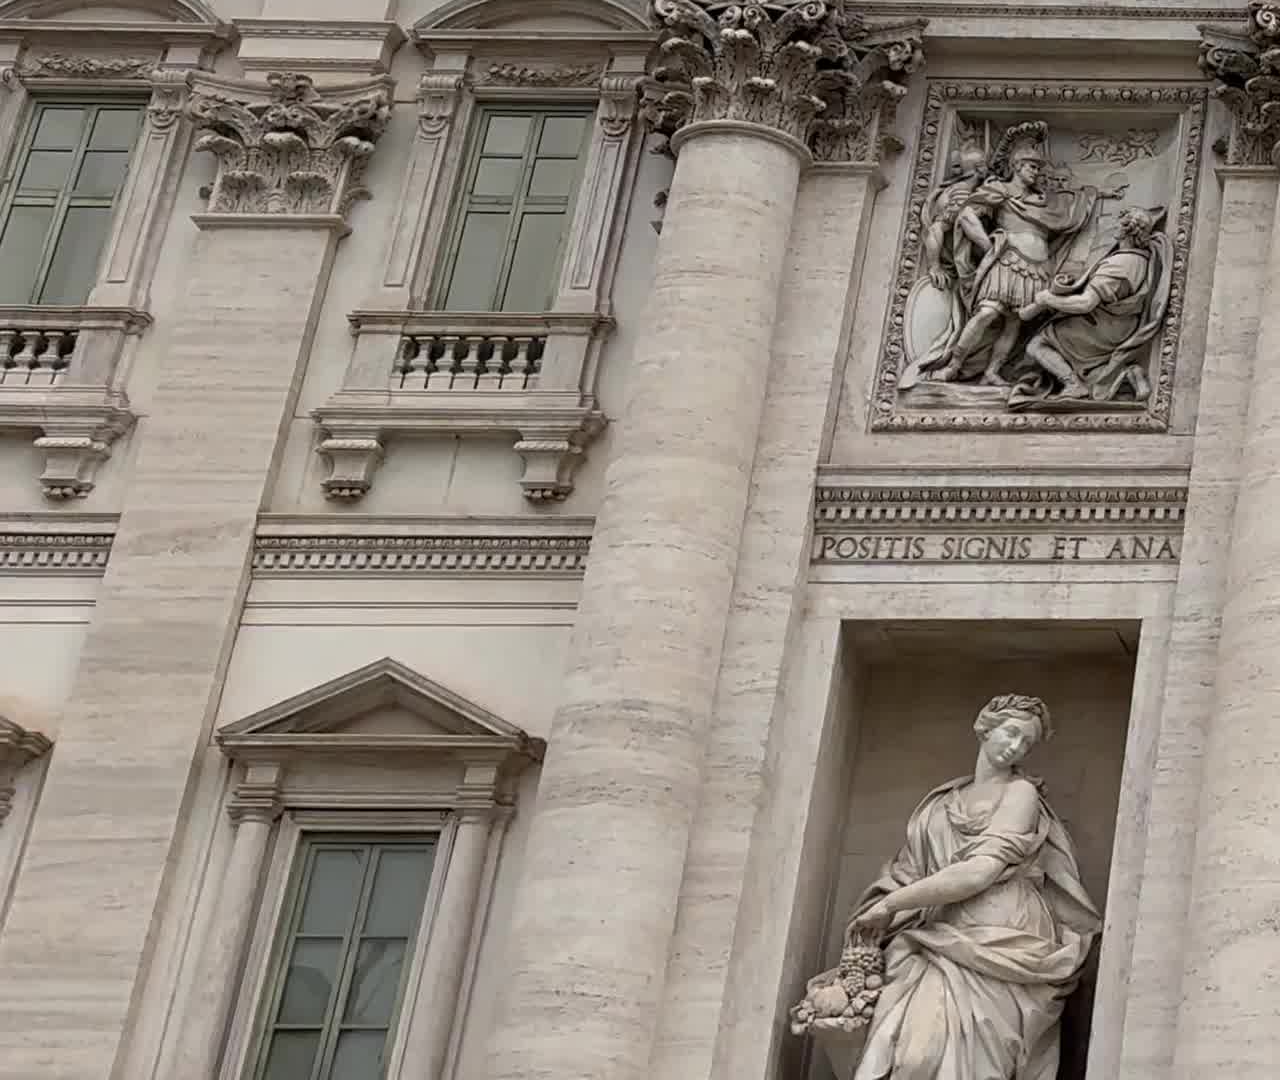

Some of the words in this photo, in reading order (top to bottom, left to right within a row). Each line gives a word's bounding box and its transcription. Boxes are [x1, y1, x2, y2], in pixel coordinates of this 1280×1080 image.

[820, 536, 926, 560] POSITIS
[940, 536, 1033, 560] SIGNIS
[1052, 536, 1087, 560] ET
